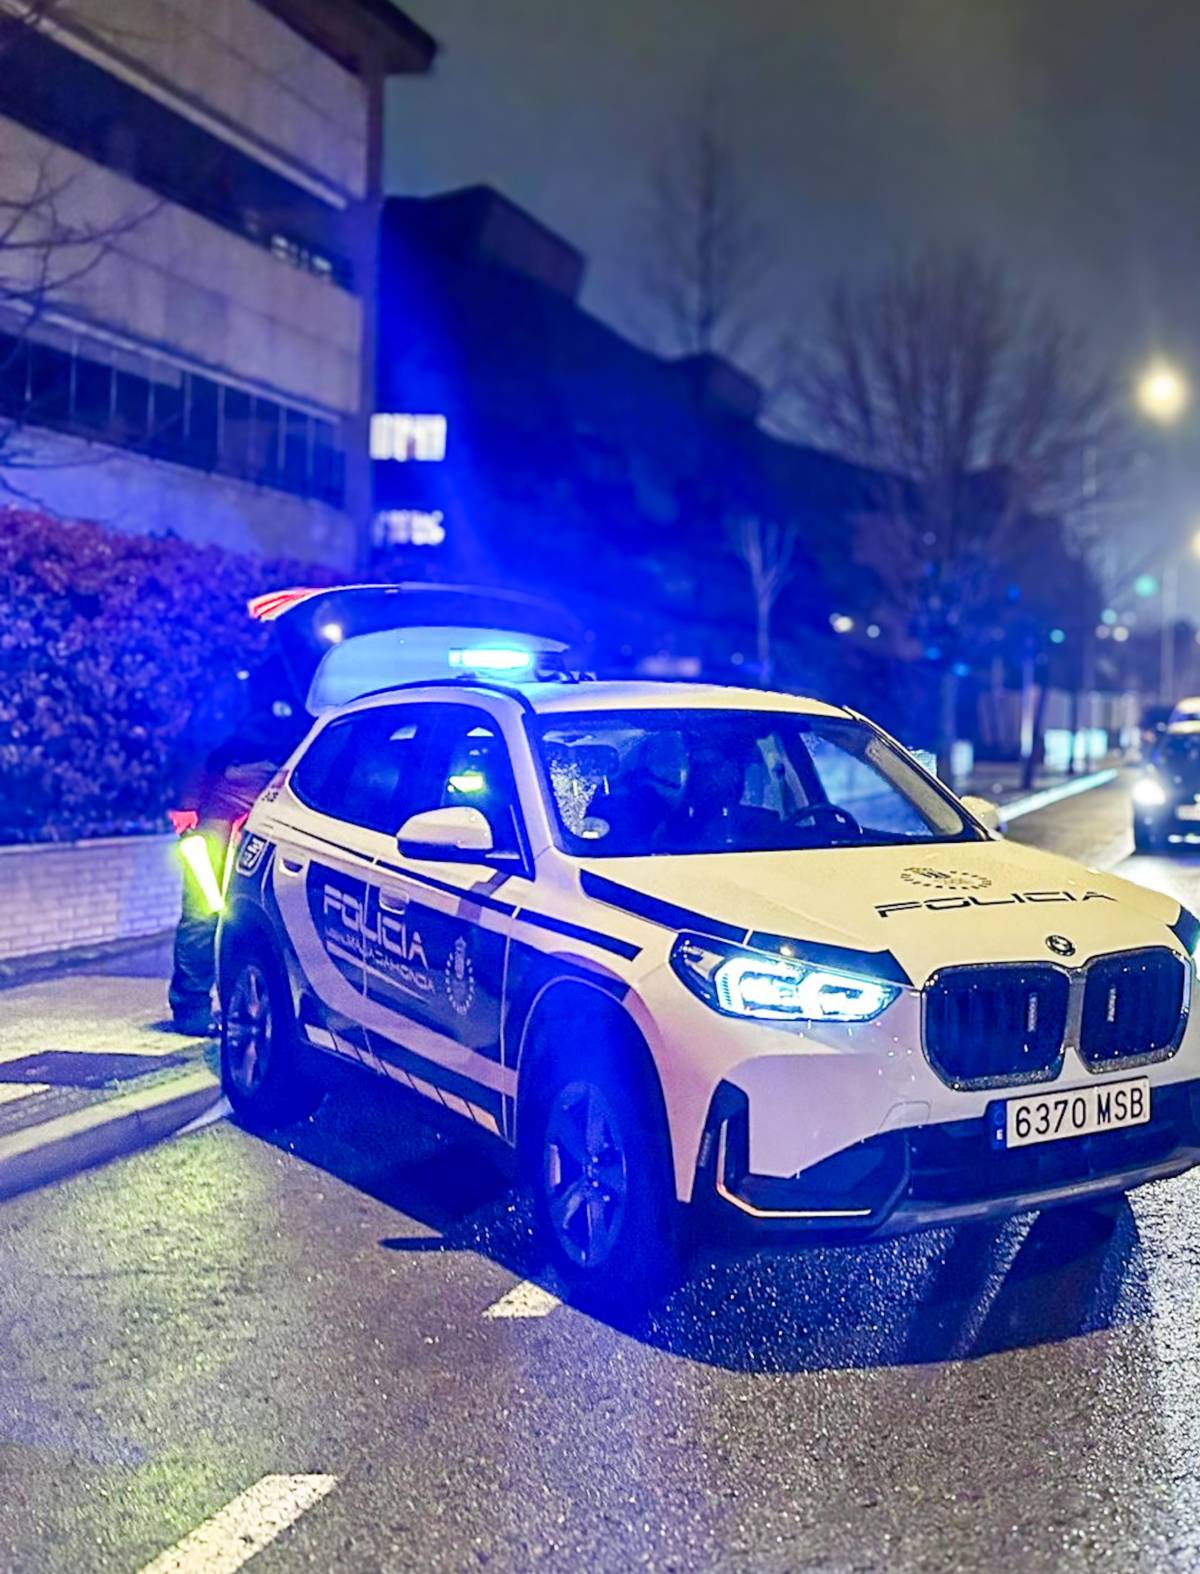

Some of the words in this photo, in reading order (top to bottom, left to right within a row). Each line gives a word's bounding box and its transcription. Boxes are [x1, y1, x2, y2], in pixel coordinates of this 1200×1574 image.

[874, 891, 1118, 918] POLICIA
[324, 884, 430, 970] POLICIA
[1015, 1097, 1087, 1138] 6370
[1097, 1087, 1143, 1126] MSB
[996, 1129, 1003, 1140] E
